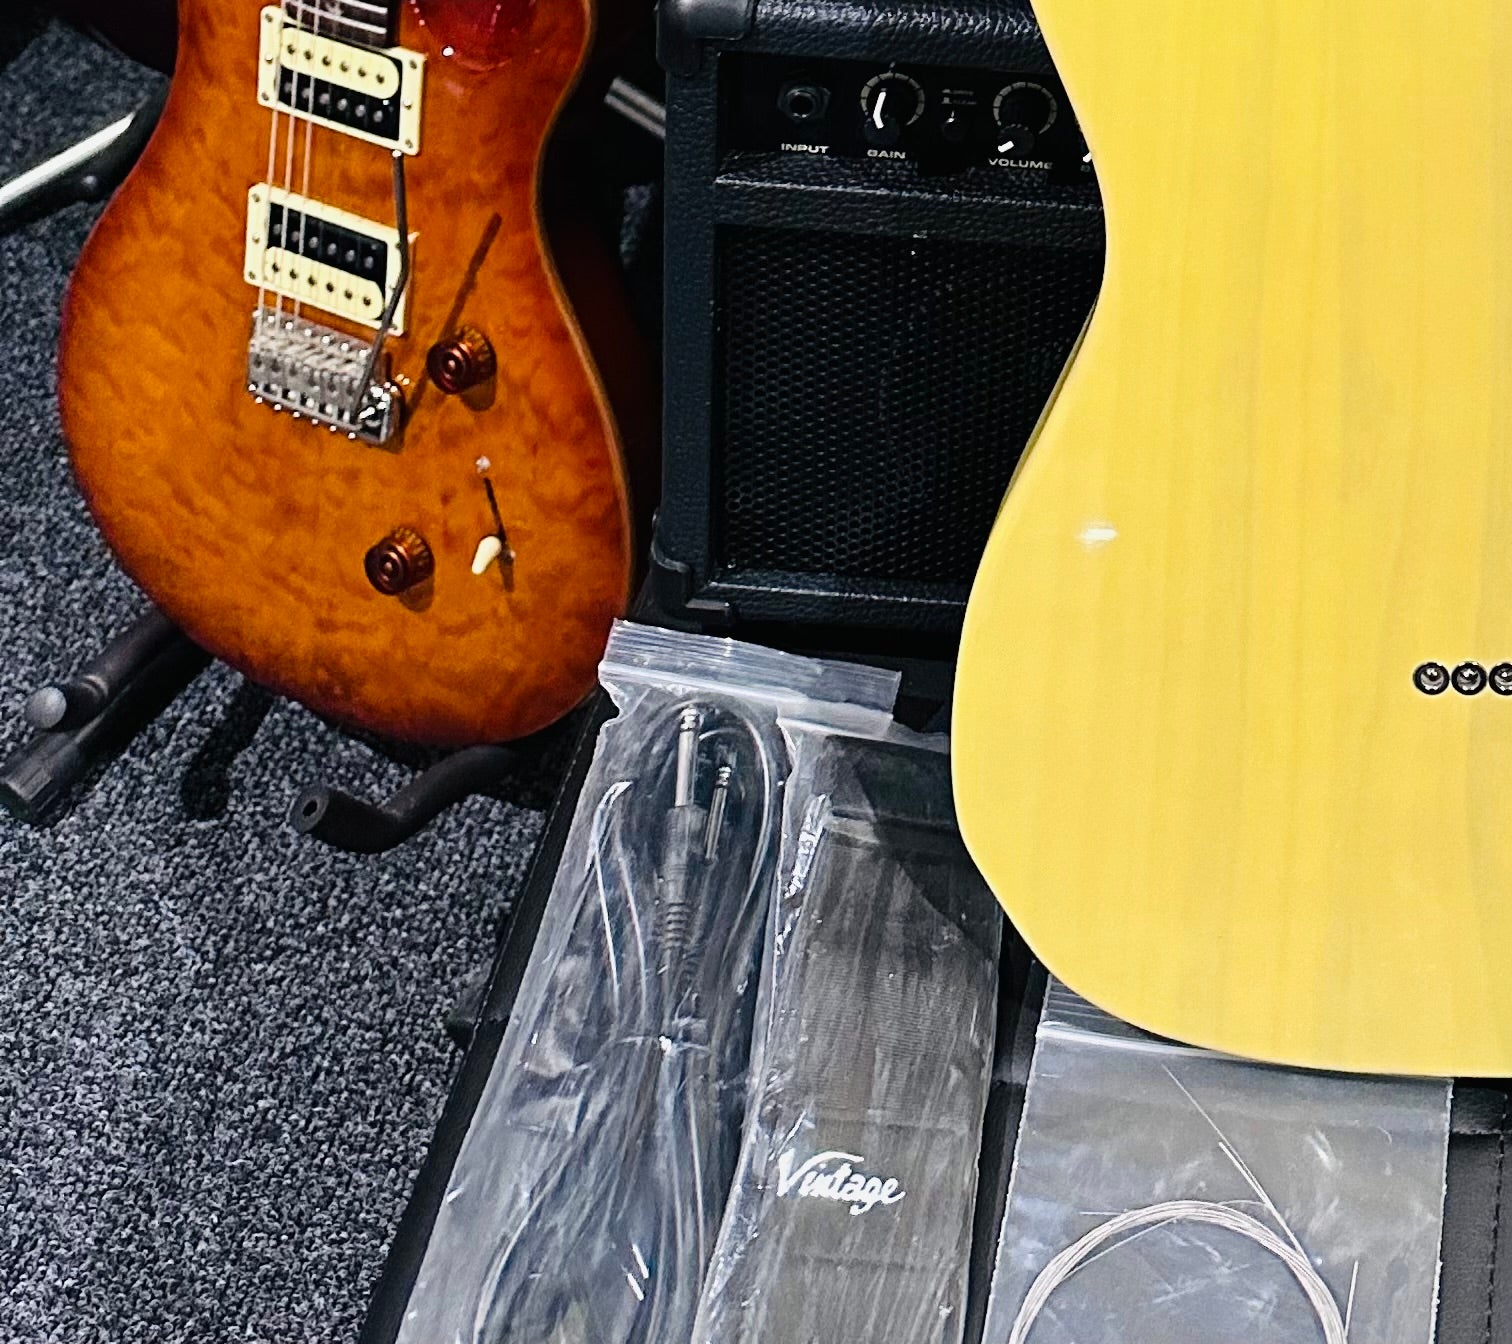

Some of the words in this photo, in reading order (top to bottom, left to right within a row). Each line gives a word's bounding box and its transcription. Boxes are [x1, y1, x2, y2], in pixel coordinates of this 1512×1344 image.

[780, 142, 830, 155] INPUT
[866, 149, 906, 160] GAIN
[988, 158, 1054, 171] VOLUME
[776, 1148, 906, 1215] Vintage
